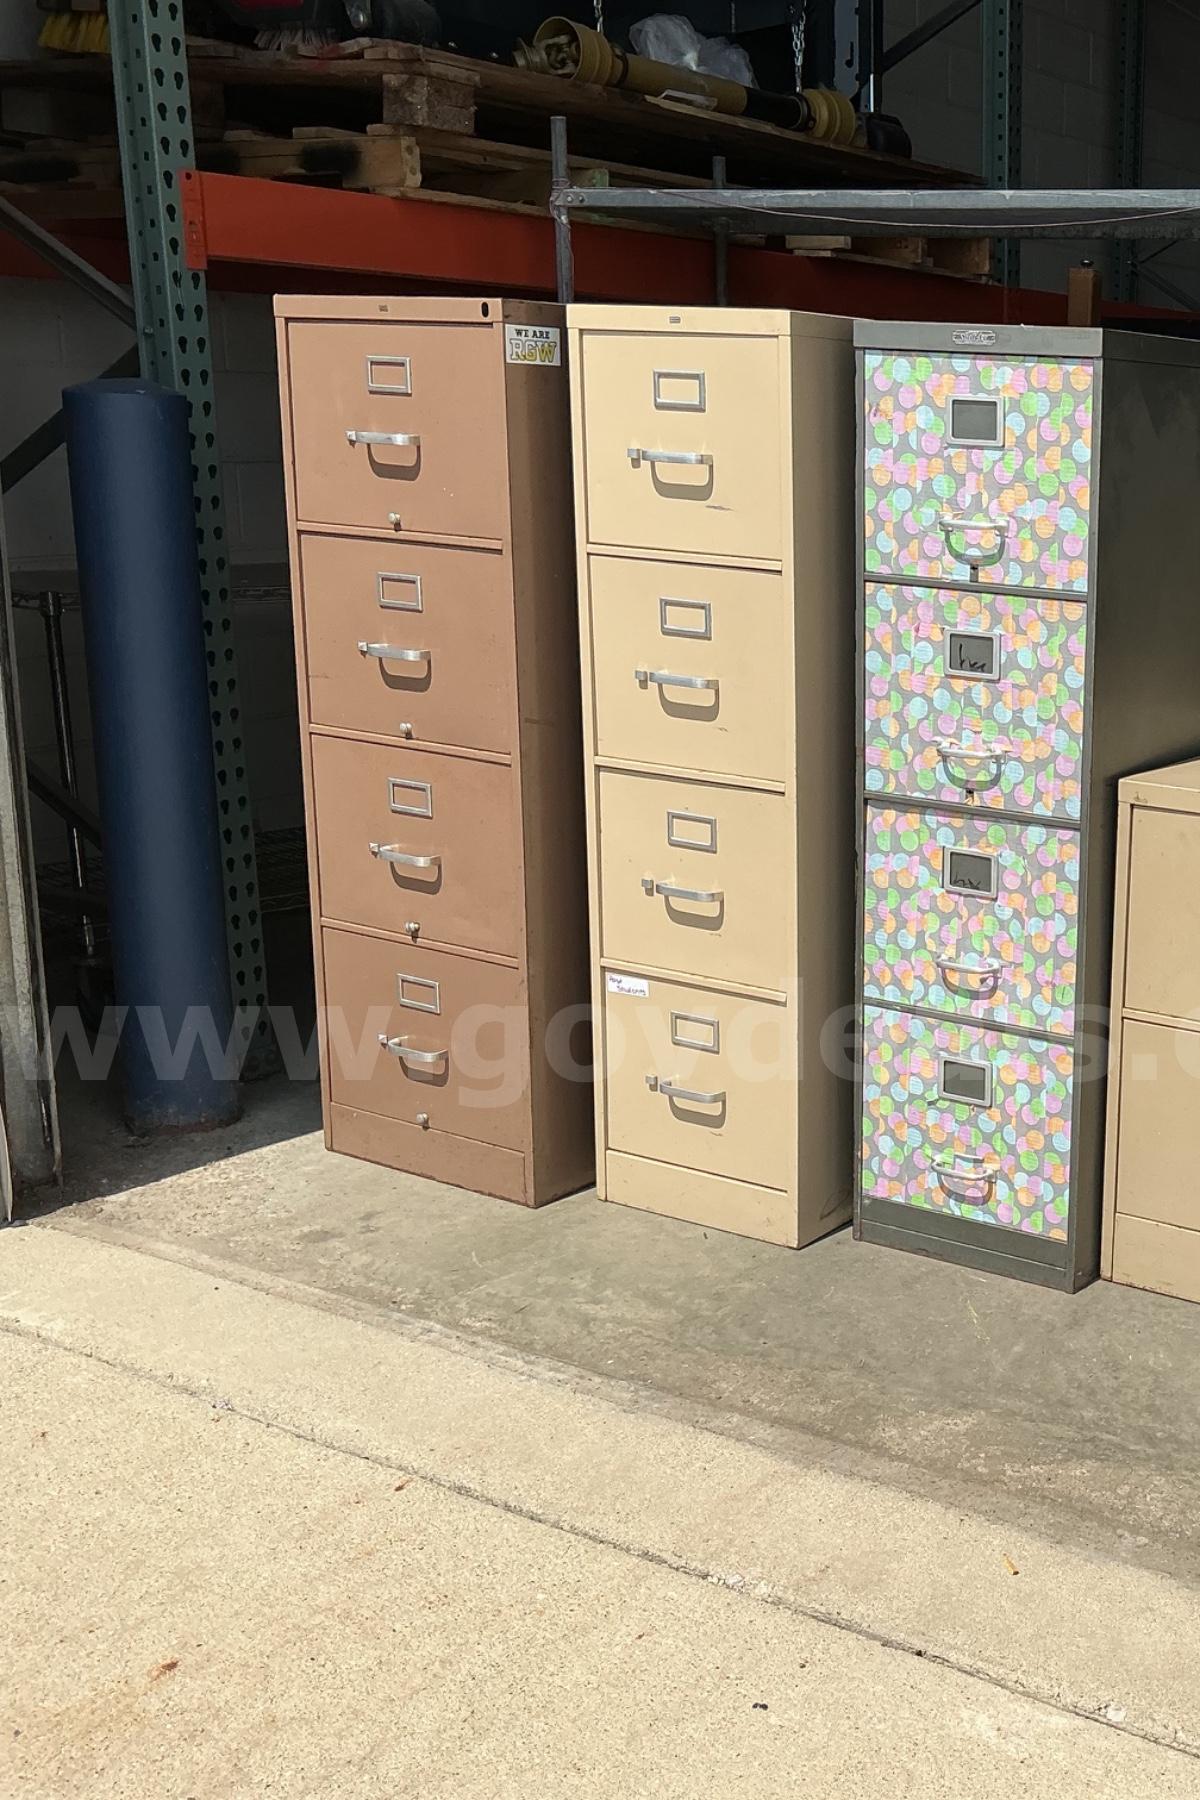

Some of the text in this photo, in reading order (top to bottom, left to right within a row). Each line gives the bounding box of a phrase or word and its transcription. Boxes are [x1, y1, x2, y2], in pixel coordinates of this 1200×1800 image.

[515, 329, 550, 339] WE ARE
[510, 338, 557, 363] RGW
